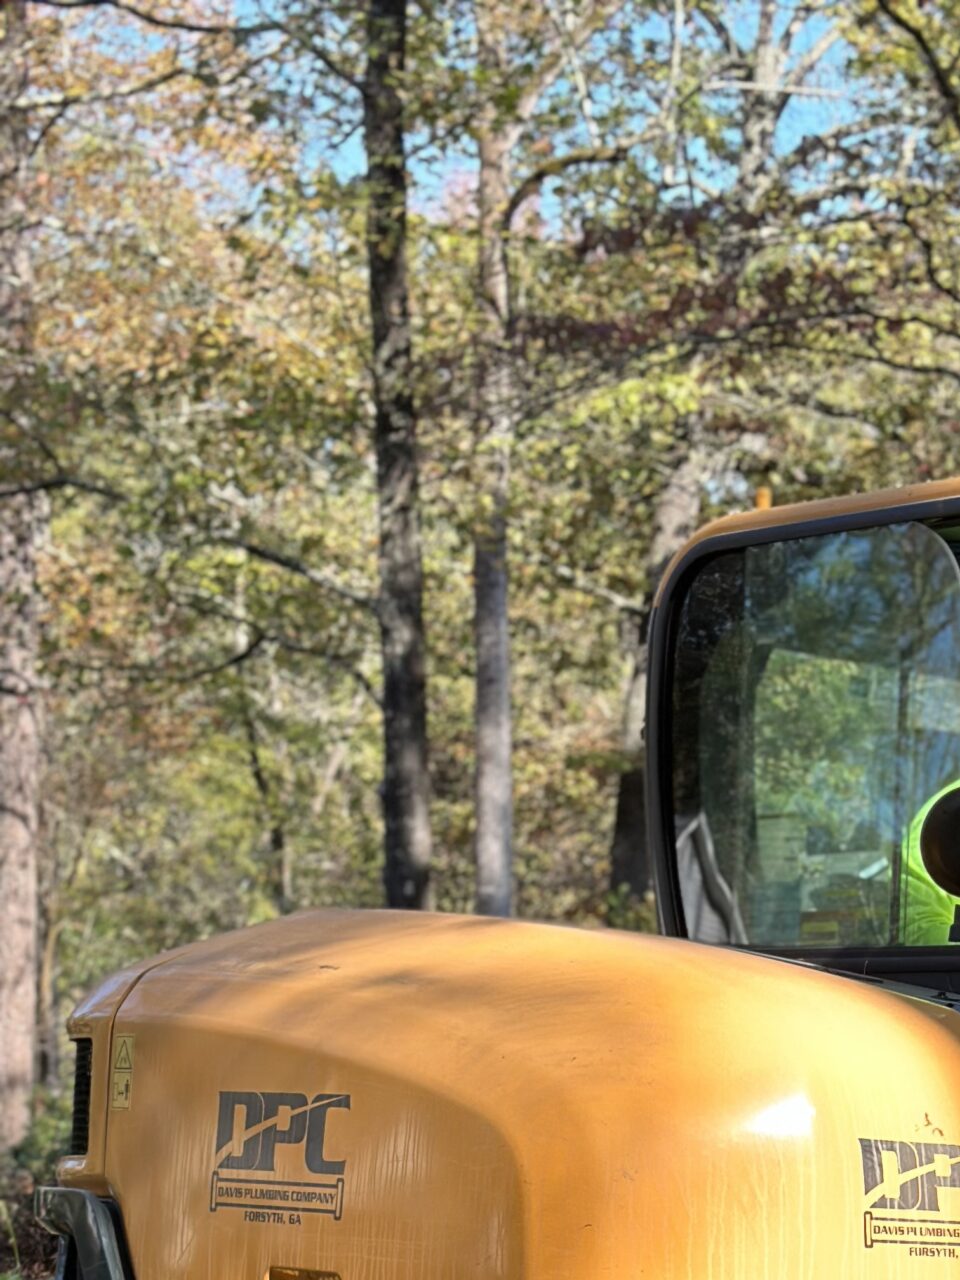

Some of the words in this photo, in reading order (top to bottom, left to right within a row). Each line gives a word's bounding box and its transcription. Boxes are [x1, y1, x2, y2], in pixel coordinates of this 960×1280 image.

[216, 1091, 350, 1175] DPC
[218, 1187, 242, 1198] DAVIS
[244, 1188, 289, 1201] PLUMBING
[291, 1191, 336, 1204] COMPANY
[289, 1213, 301, 1225] GA
[873, 1225, 904, 1235] DAVIS
[907, 1226, 960, 1238] PLUMBING
